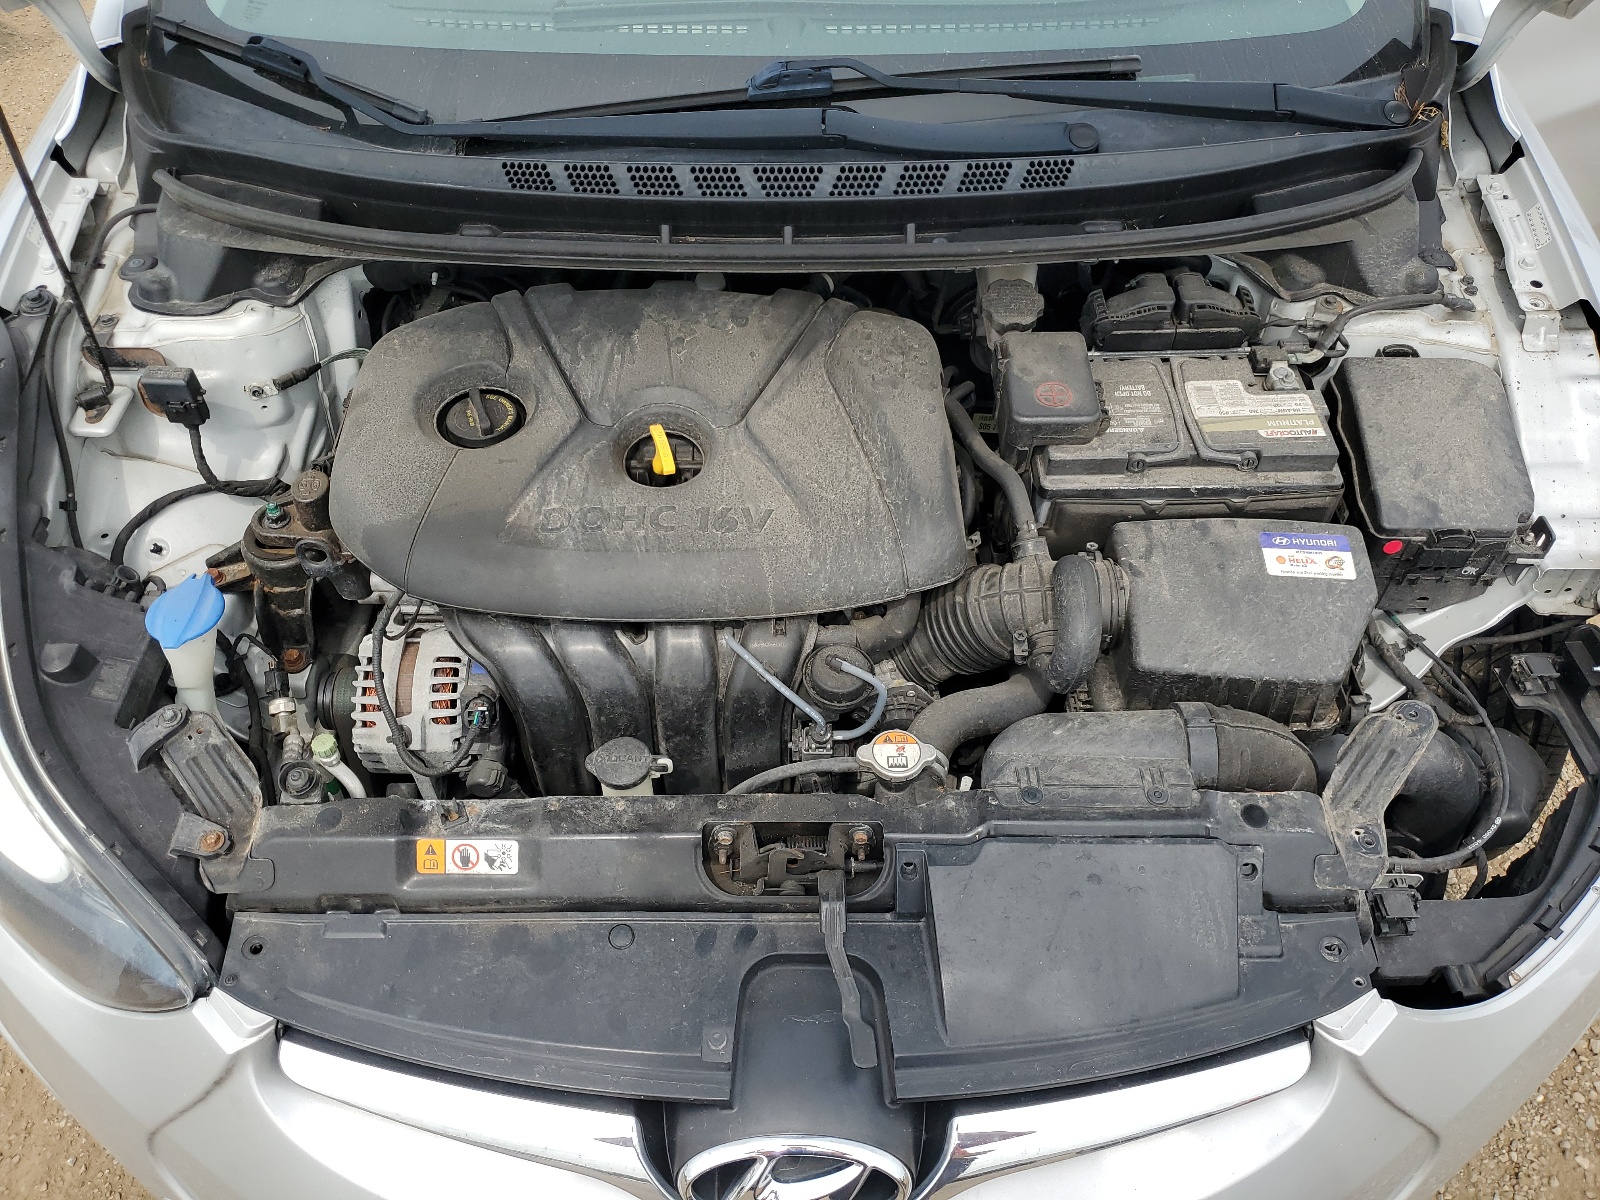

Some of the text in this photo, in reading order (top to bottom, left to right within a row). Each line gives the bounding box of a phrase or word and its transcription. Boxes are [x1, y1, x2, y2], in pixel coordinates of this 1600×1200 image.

[1266, 419, 1315, 427] PLATINUM
[538, 505, 776, 534] DOHC 16V
[1292, 538, 1337, 547] HYUNDAI
